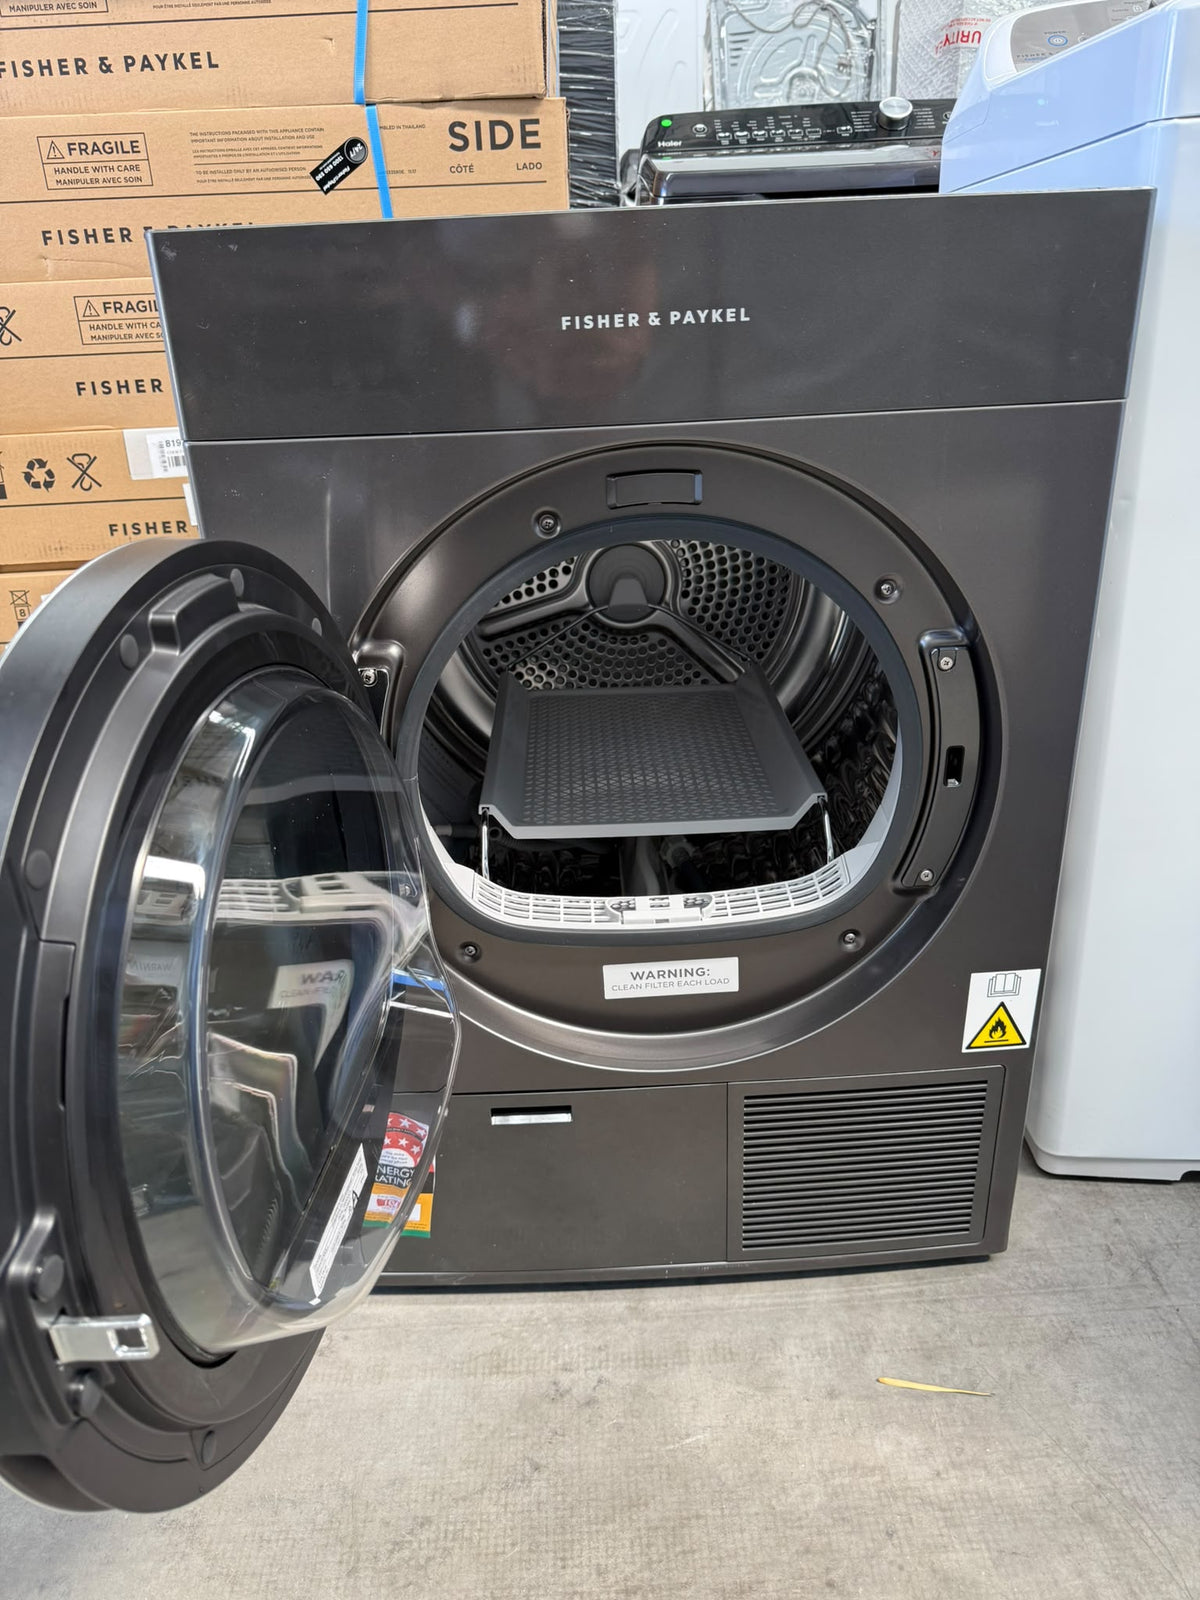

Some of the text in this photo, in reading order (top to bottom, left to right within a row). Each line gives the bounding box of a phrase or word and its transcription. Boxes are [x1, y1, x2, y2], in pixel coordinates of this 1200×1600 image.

[9, 3, 54, 12] MANIPULER
[56, 2, 77, 10] AVEC
[0, 52, 219, 78] FISHER & PAYKEL
[448, 118, 542, 152] SIDE
[67, 140, 141, 156] FRAGILE
[658, 140, 682, 148] Haier
[54, 164, 141, 175] HANDLE WITH CARE
[450, 162, 542, 174] CÔTÉ LADO
[56, 178, 100, 186] MANIPULER
[42, 227, 133, 246] FISHER
[103, 300, 159, 314] FRAGIL
[561, 308, 750, 330] FISHER & PAYKEL
[89, 323, 124, 331] HANDLE
[76, 378, 163, 396] FISHER
[108, 520, 188, 536] FISHER
[19, 608, 26, 617] 8
[630, 967, 710, 981] WARNING:
[611, 984, 642, 992] CLEAN
[645, 981, 674, 989] FILTER
[677, 979, 702, 987] EACH
[376, 1164, 415, 1178] NERGY
